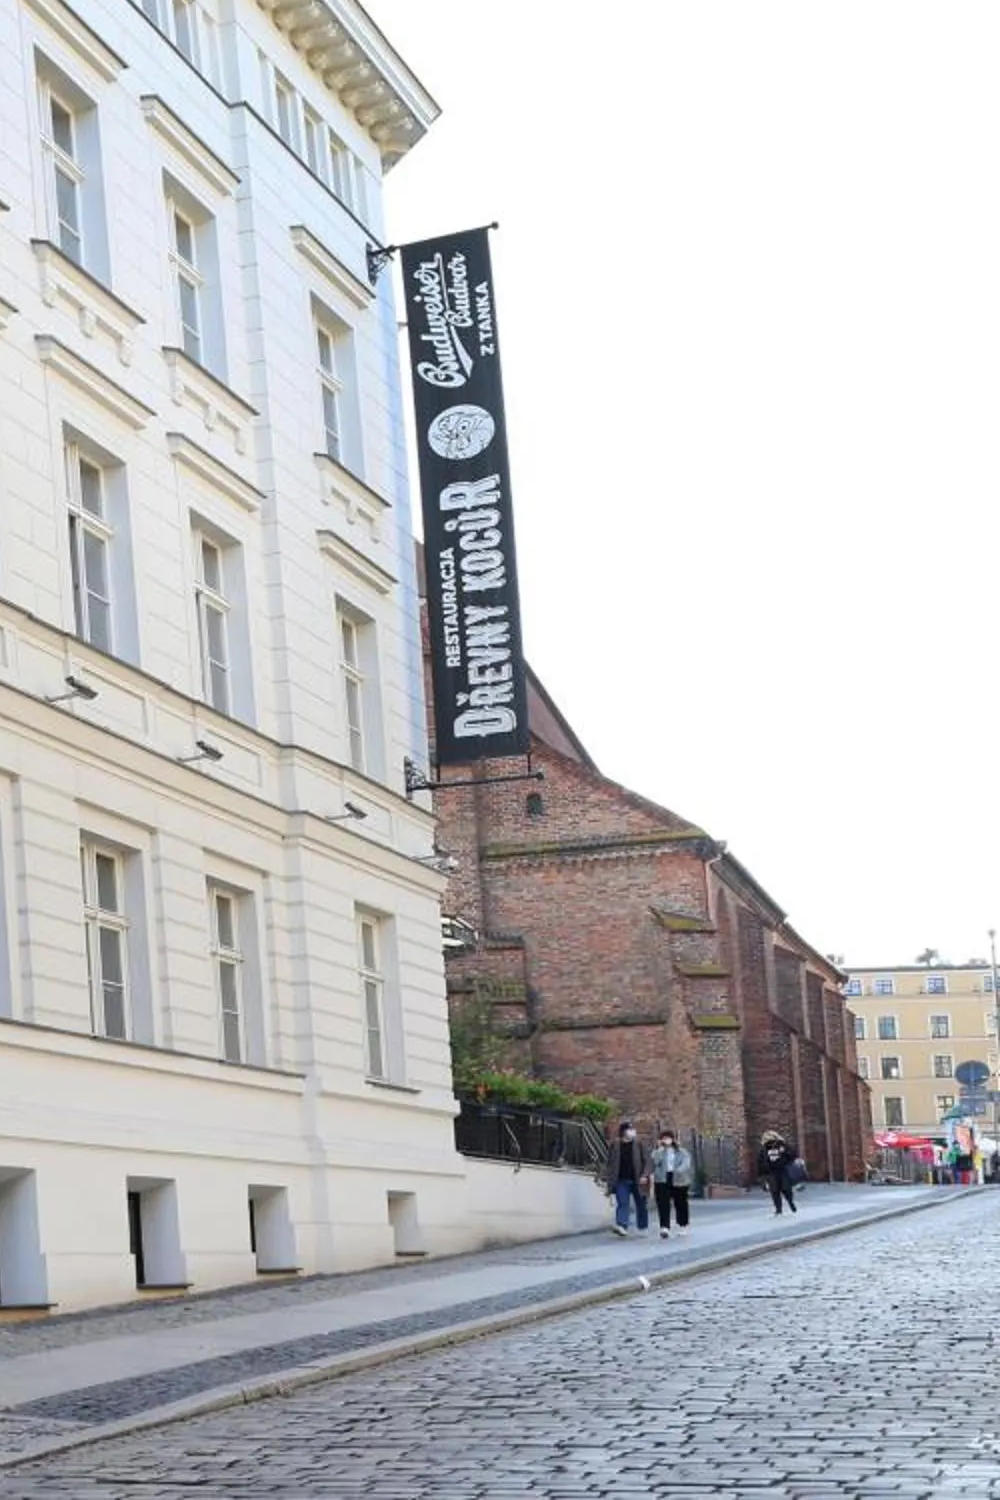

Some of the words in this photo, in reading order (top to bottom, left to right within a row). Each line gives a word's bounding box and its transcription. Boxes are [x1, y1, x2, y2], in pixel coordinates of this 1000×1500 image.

[413, 252, 468, 389] Budweiser
[443, 251, 475, 328] Budvar
[474, 280, 495, 341] TANKA
[479, 342, 496, 357] Z
[439, 546, 462, 668] RESTAURACJA
